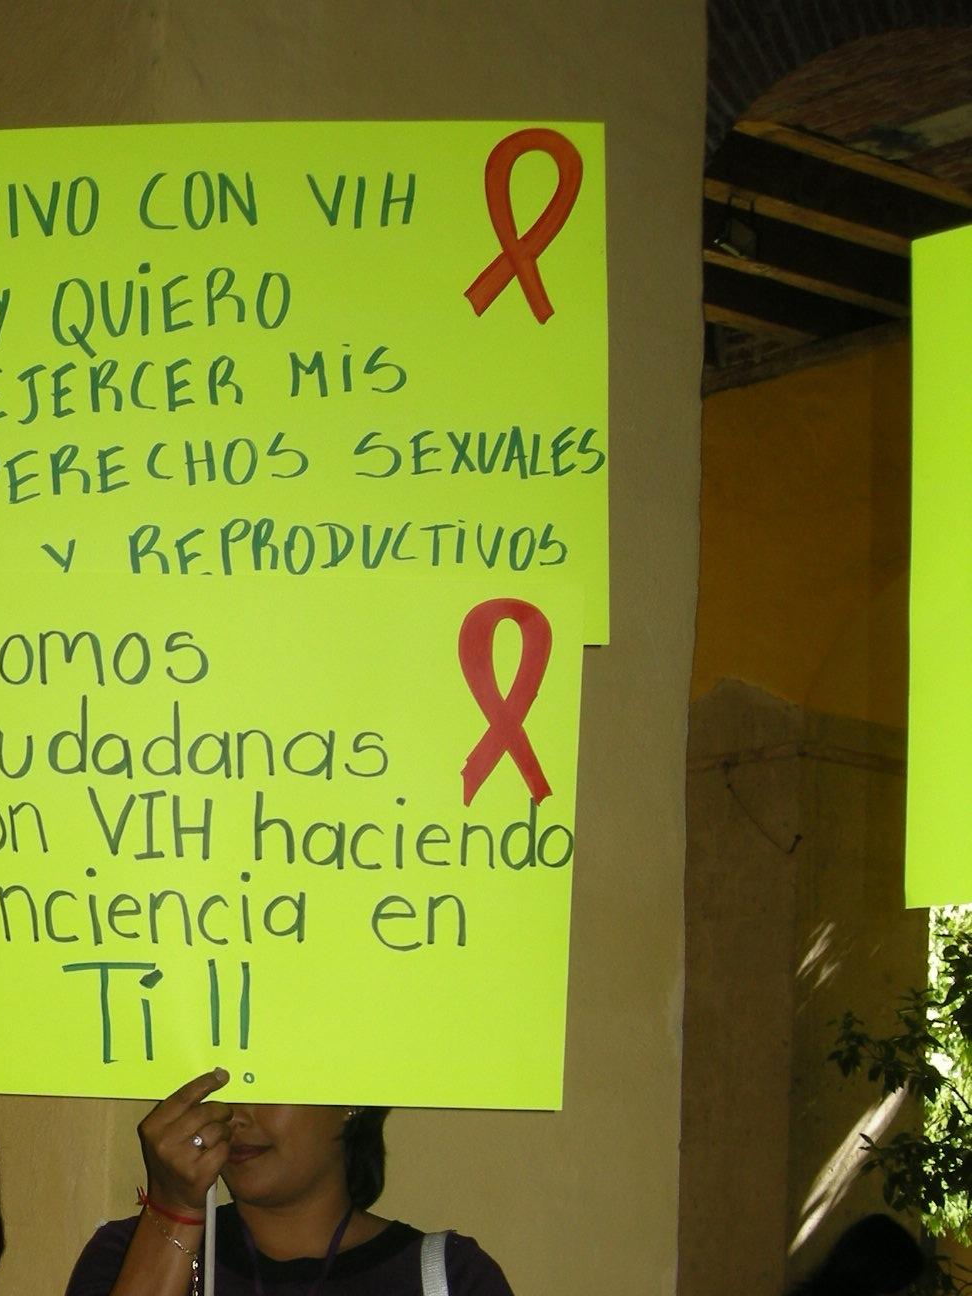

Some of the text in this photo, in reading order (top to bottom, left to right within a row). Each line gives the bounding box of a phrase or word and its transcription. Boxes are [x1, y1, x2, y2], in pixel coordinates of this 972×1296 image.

[140, 171, 257, 230] CON
[307, 173, 415, 229] VIH
[354, 426, 605, 479] SEXUALES
[88, 786, 212, 861] VIH
[255, 791, 574, 870] haciendo
[372, 895, 466, 951] en
